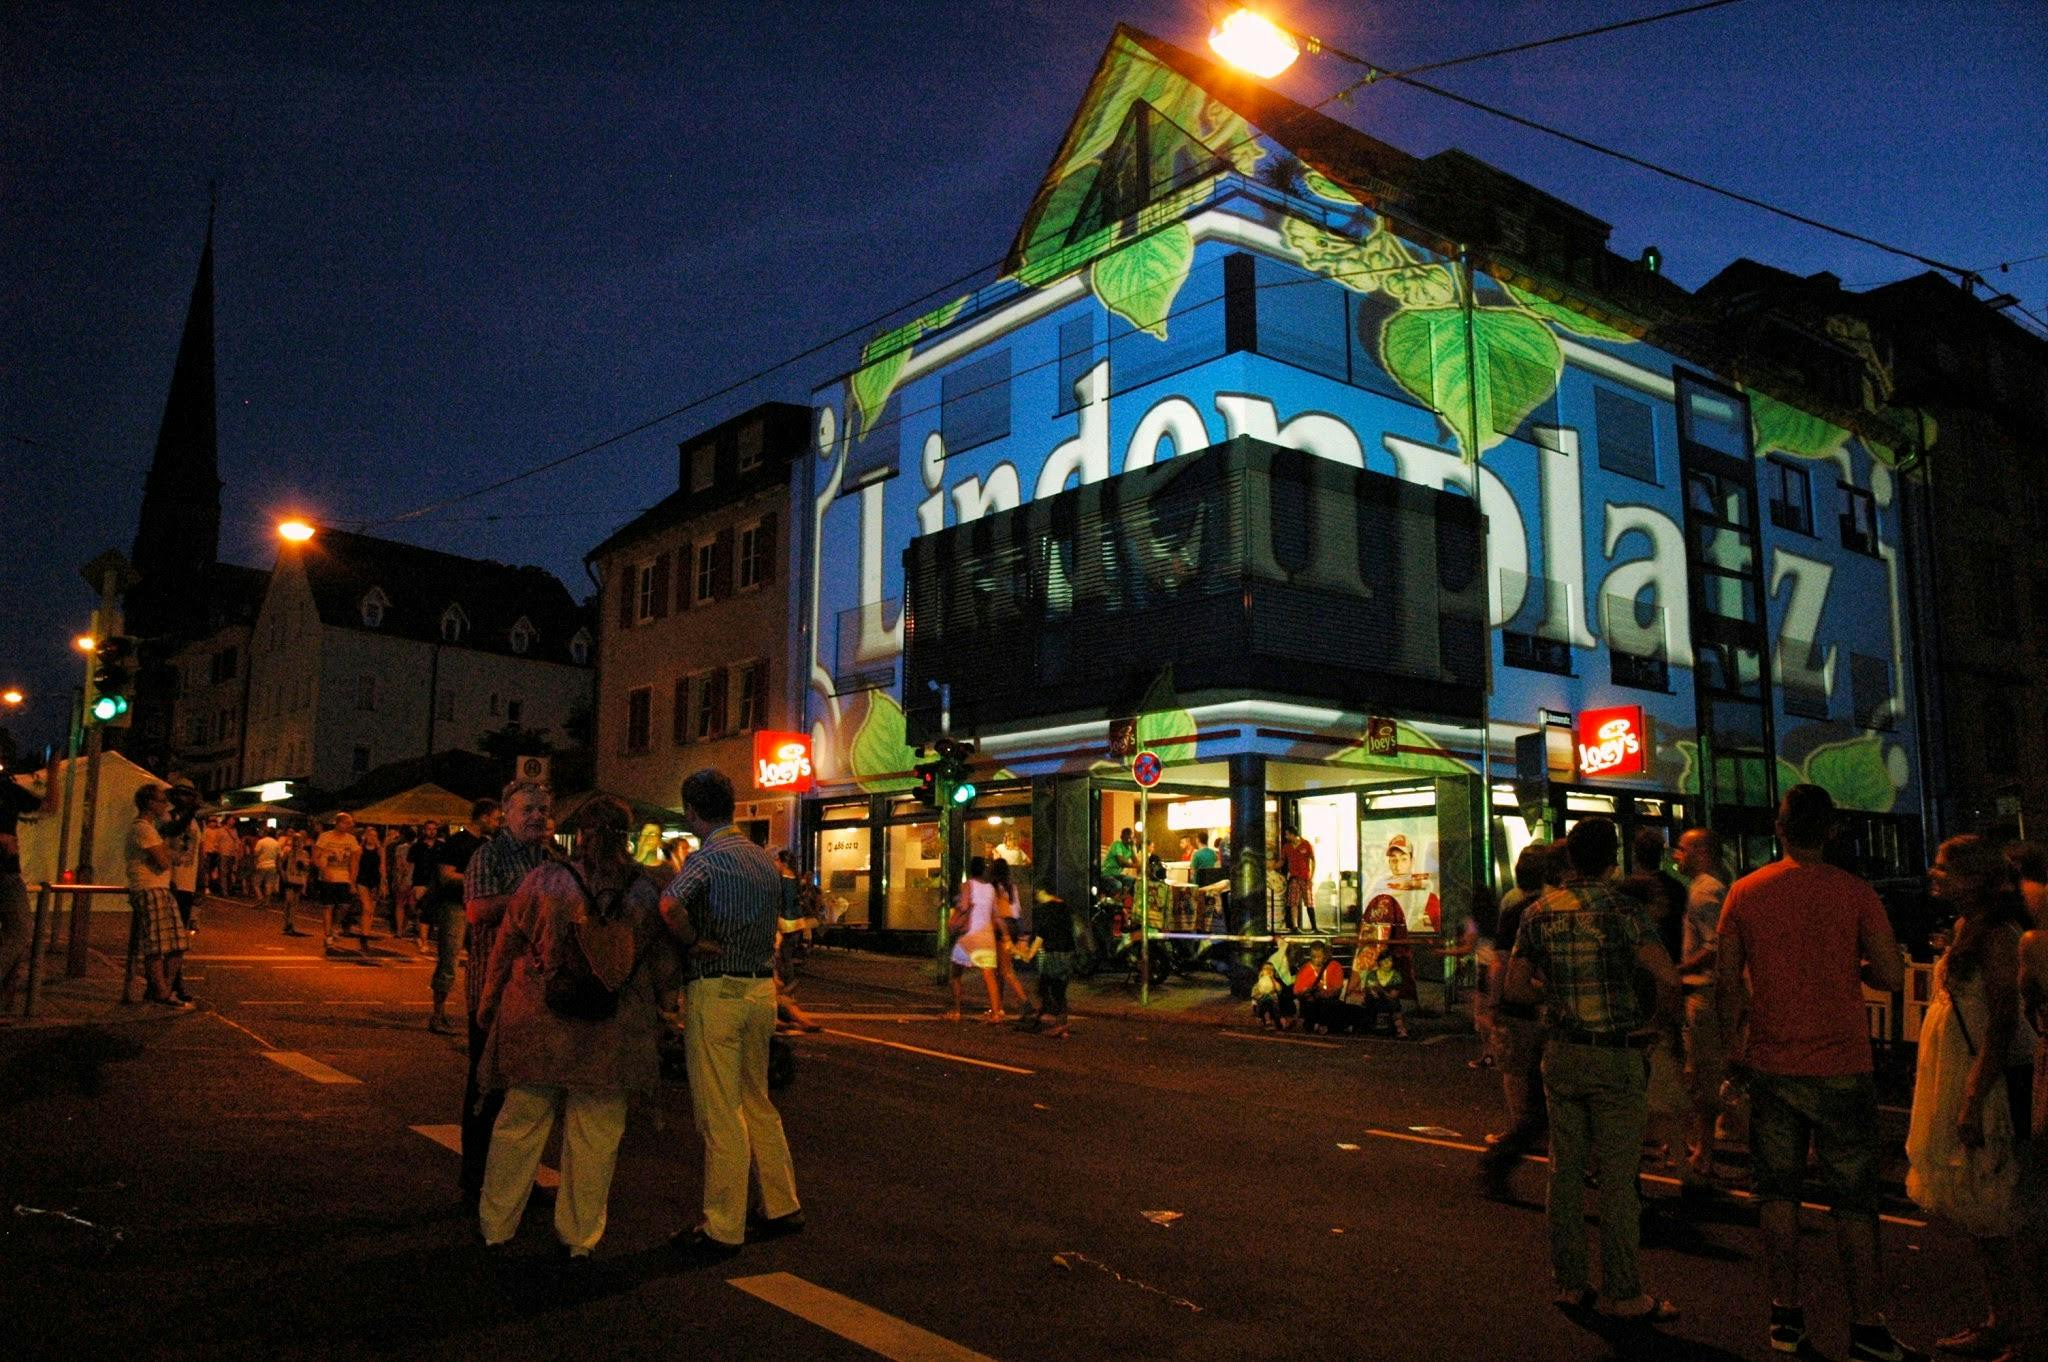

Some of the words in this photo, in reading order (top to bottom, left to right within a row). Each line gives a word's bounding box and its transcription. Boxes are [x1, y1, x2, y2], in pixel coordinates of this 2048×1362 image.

[852, 361, 1838, 697] Lindenplatz
[1370, 735, 1396, 752] Joey's
[1579, 732, 1639, 770] Joey's
[759, 757, 811, 785] Joey's
